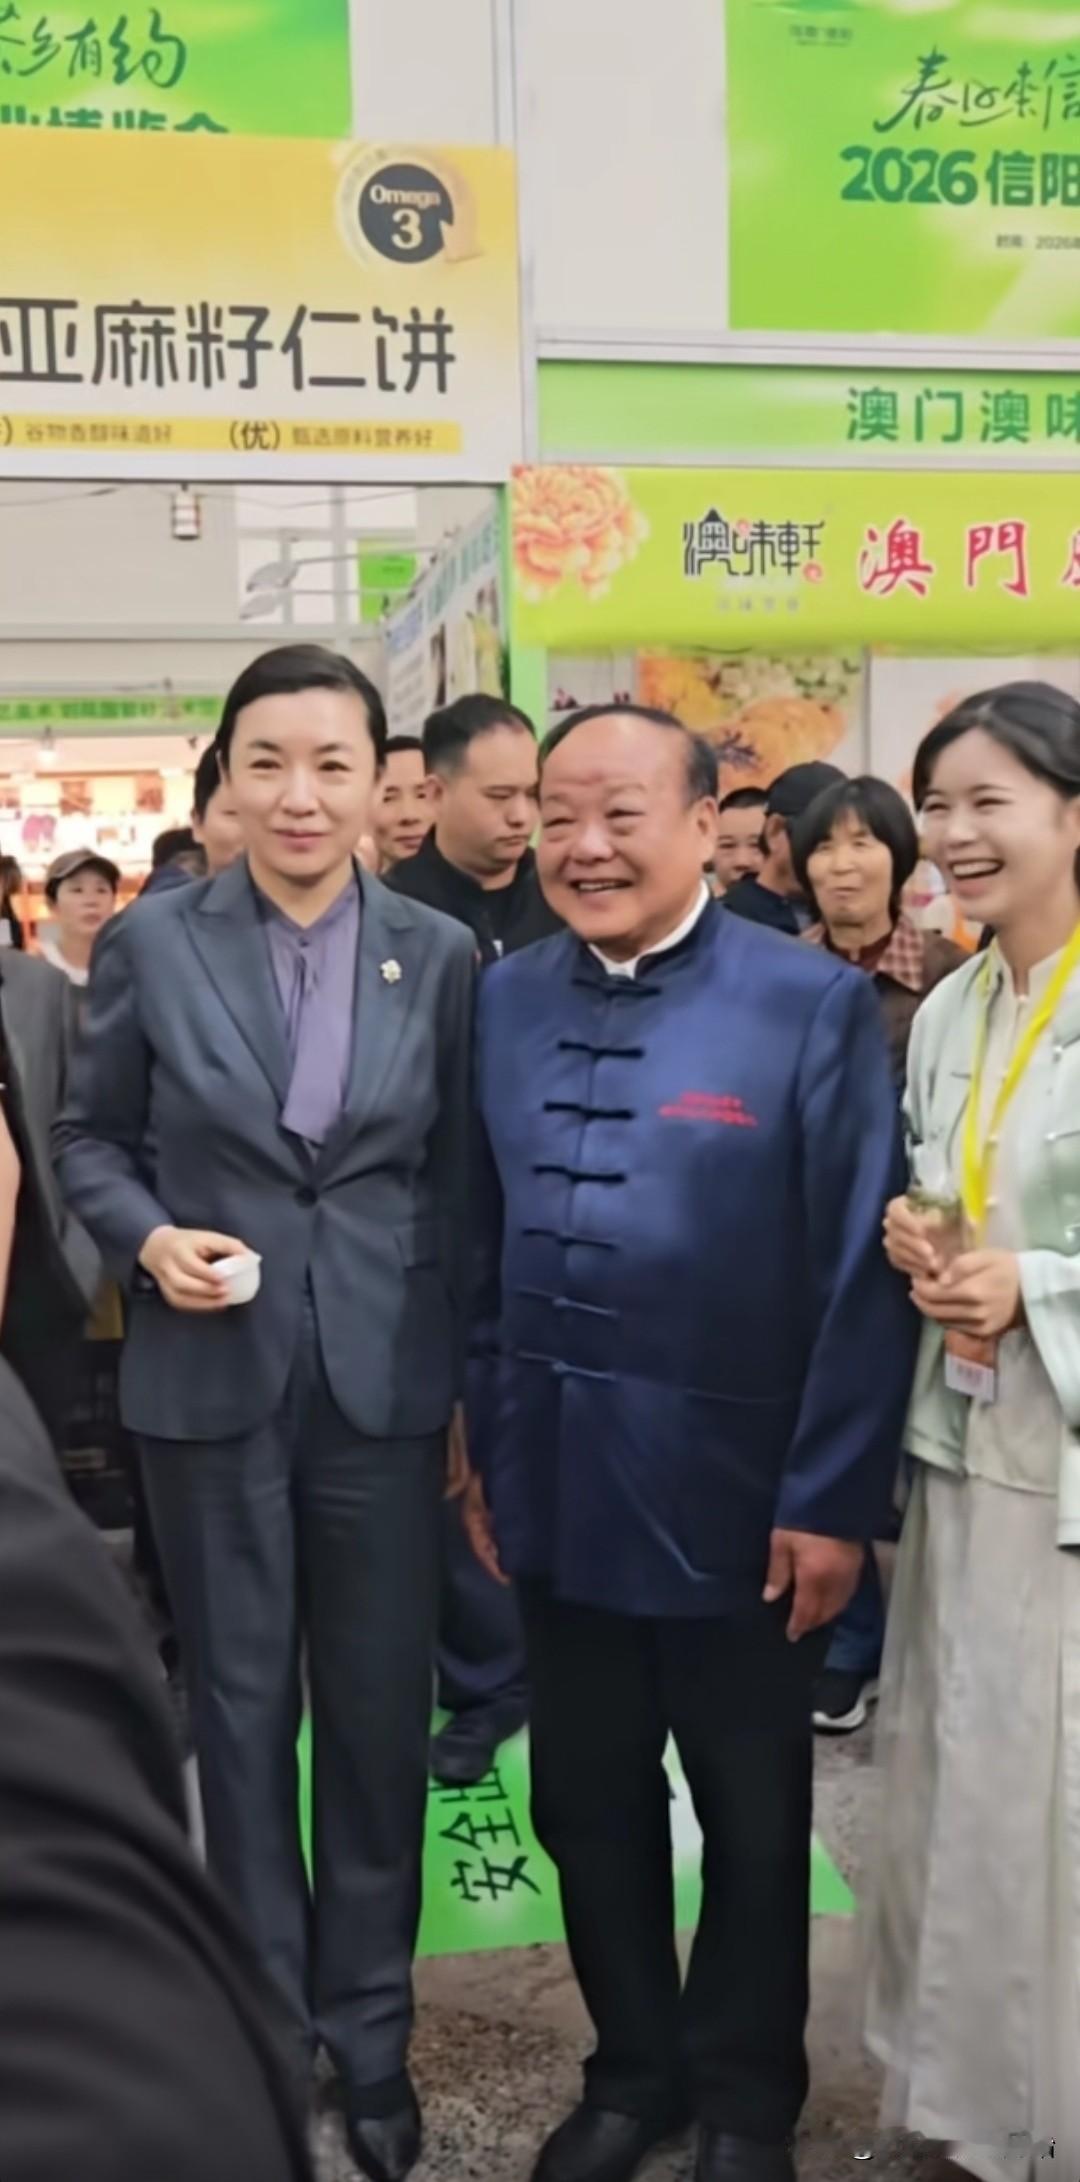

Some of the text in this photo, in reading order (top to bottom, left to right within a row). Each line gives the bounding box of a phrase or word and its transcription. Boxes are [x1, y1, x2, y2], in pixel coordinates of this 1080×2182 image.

[370, 183, 440, 209] Omega
[391, 208, 422, 249] 3
[0, 299, 456, 393] 亚麻籽仁饼
